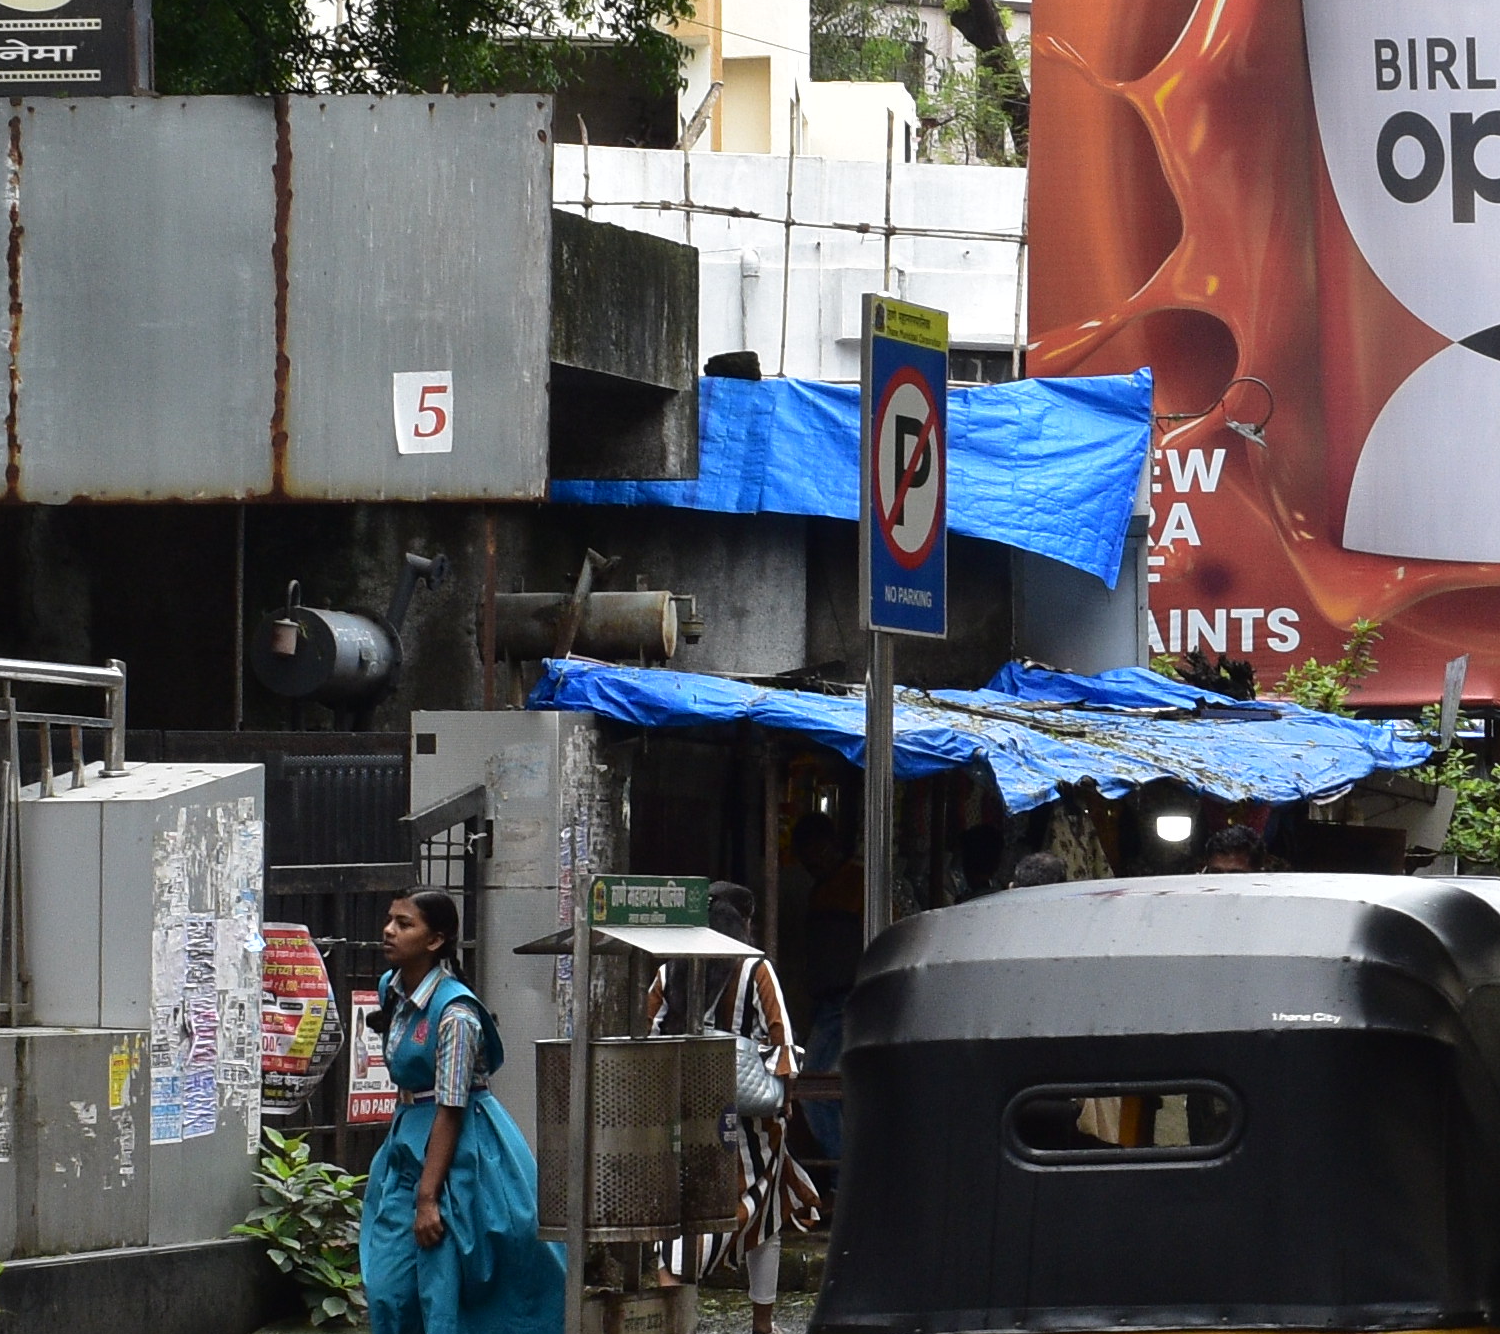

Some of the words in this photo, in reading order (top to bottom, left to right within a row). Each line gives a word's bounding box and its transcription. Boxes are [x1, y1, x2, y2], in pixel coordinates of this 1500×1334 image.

[413, 386, 448, 438] 5
[885, 585, 896, 603] NO
[898, 586, 932, 608] PARKING
